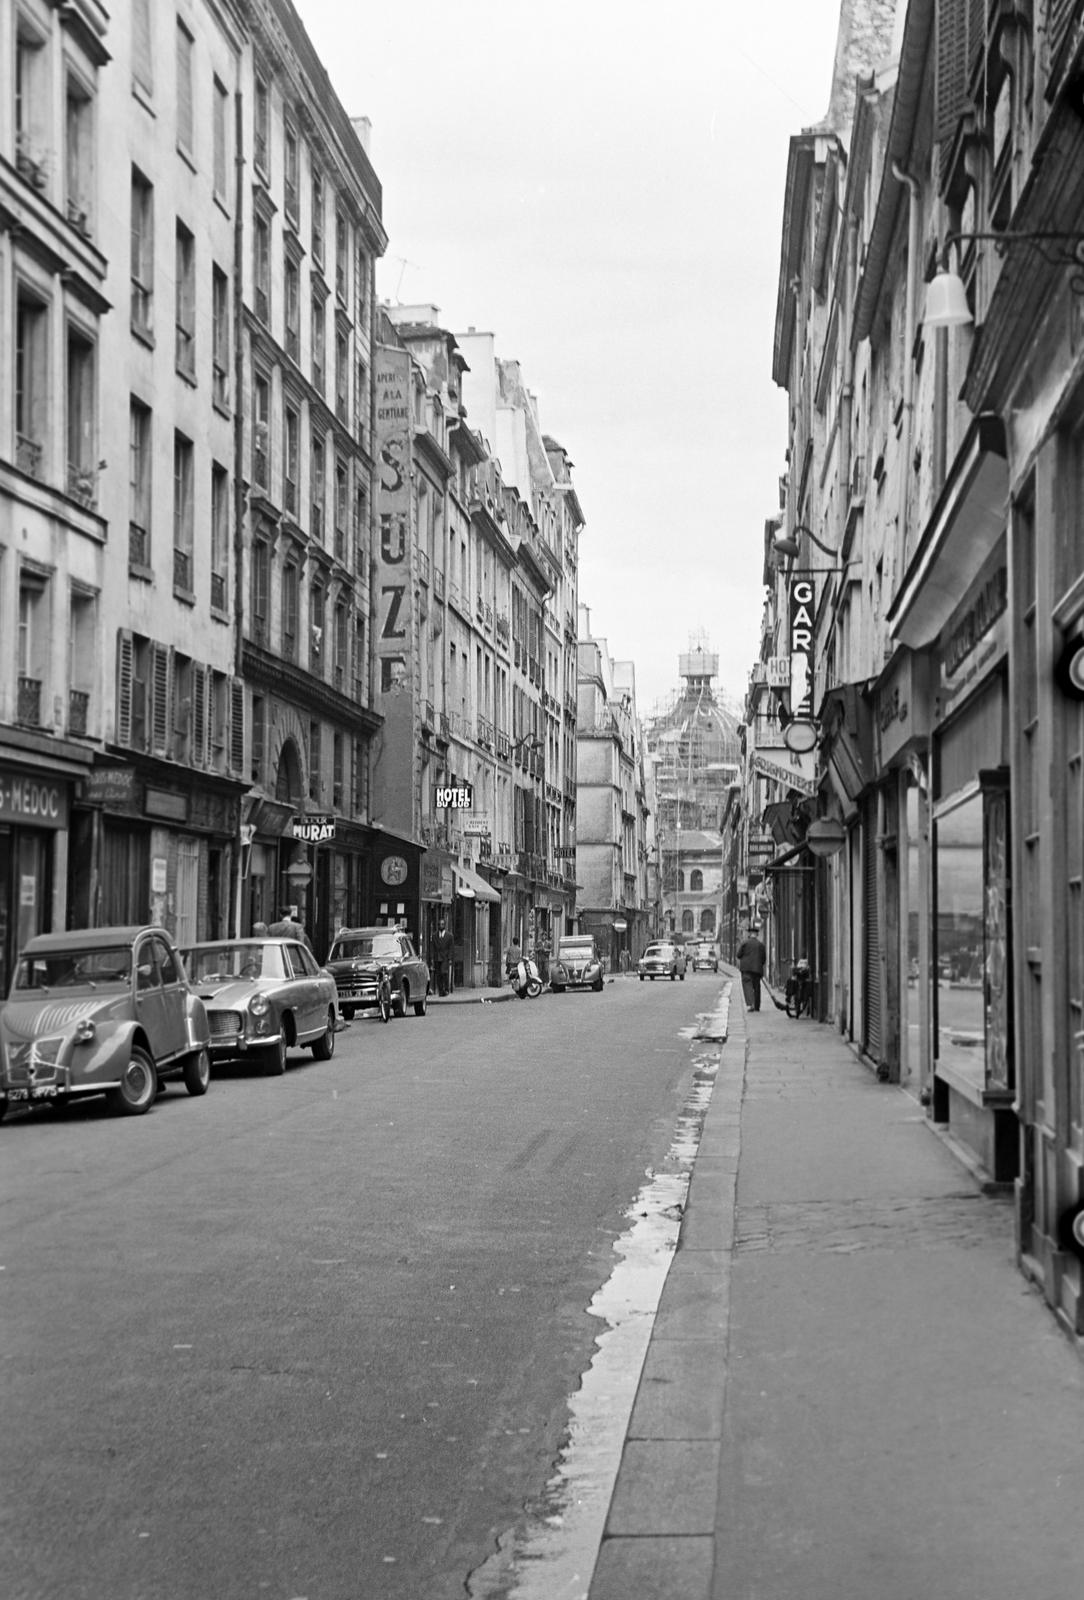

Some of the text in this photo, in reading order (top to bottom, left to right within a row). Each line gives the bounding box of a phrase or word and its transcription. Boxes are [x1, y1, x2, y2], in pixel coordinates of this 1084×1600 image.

[380, 440, 406, 693] SUZE
[793, 582, 812, 721] GARE
[770, 660, 790, 674] HO
[436, 788, 470, 802] HOTEL
[293, 825, 334, 841] MURAT
